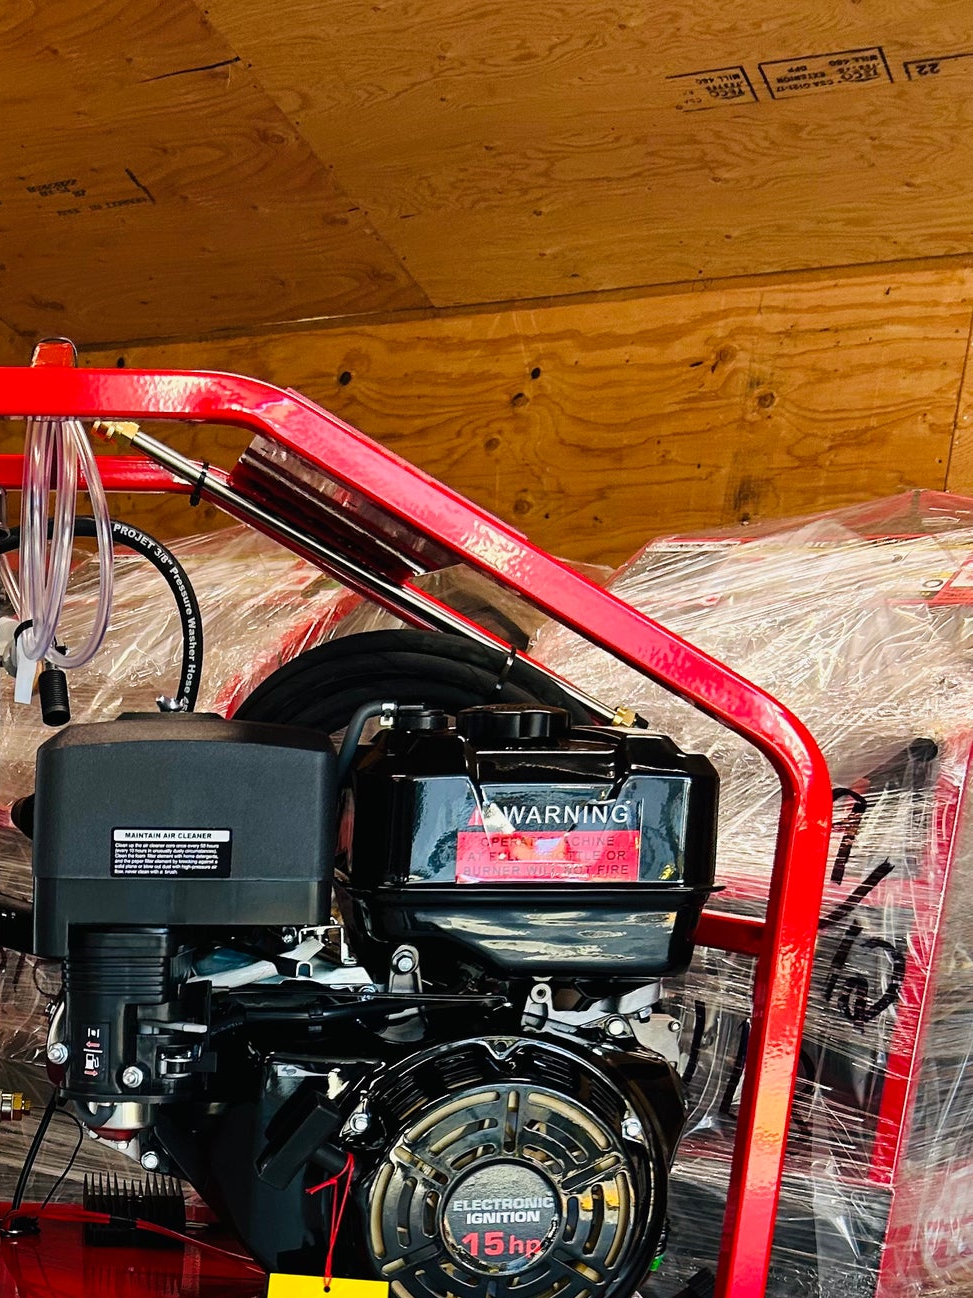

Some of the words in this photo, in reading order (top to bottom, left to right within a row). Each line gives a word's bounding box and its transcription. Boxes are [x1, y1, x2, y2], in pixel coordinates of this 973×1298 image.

[917, 62, 941, 76] 22
[113, 523, 155, 549] PROJET
[153, 548, 173, 565] 3/8"
[169, 566, 193, 615] Pressure
[187, 617, 197, 661] Washer
[183, 664, 196, 693] Hose
[503, 805, 628, 824] WARNING
[480, 836, 540, 848] OPERAT
[606, 850, 626, 860] OR
[597, 864, 629, 875] FIRE
[453, 1196, 555, 1211] ELECTRONIC
[466, 1210, 541, 1224] IGNITION
